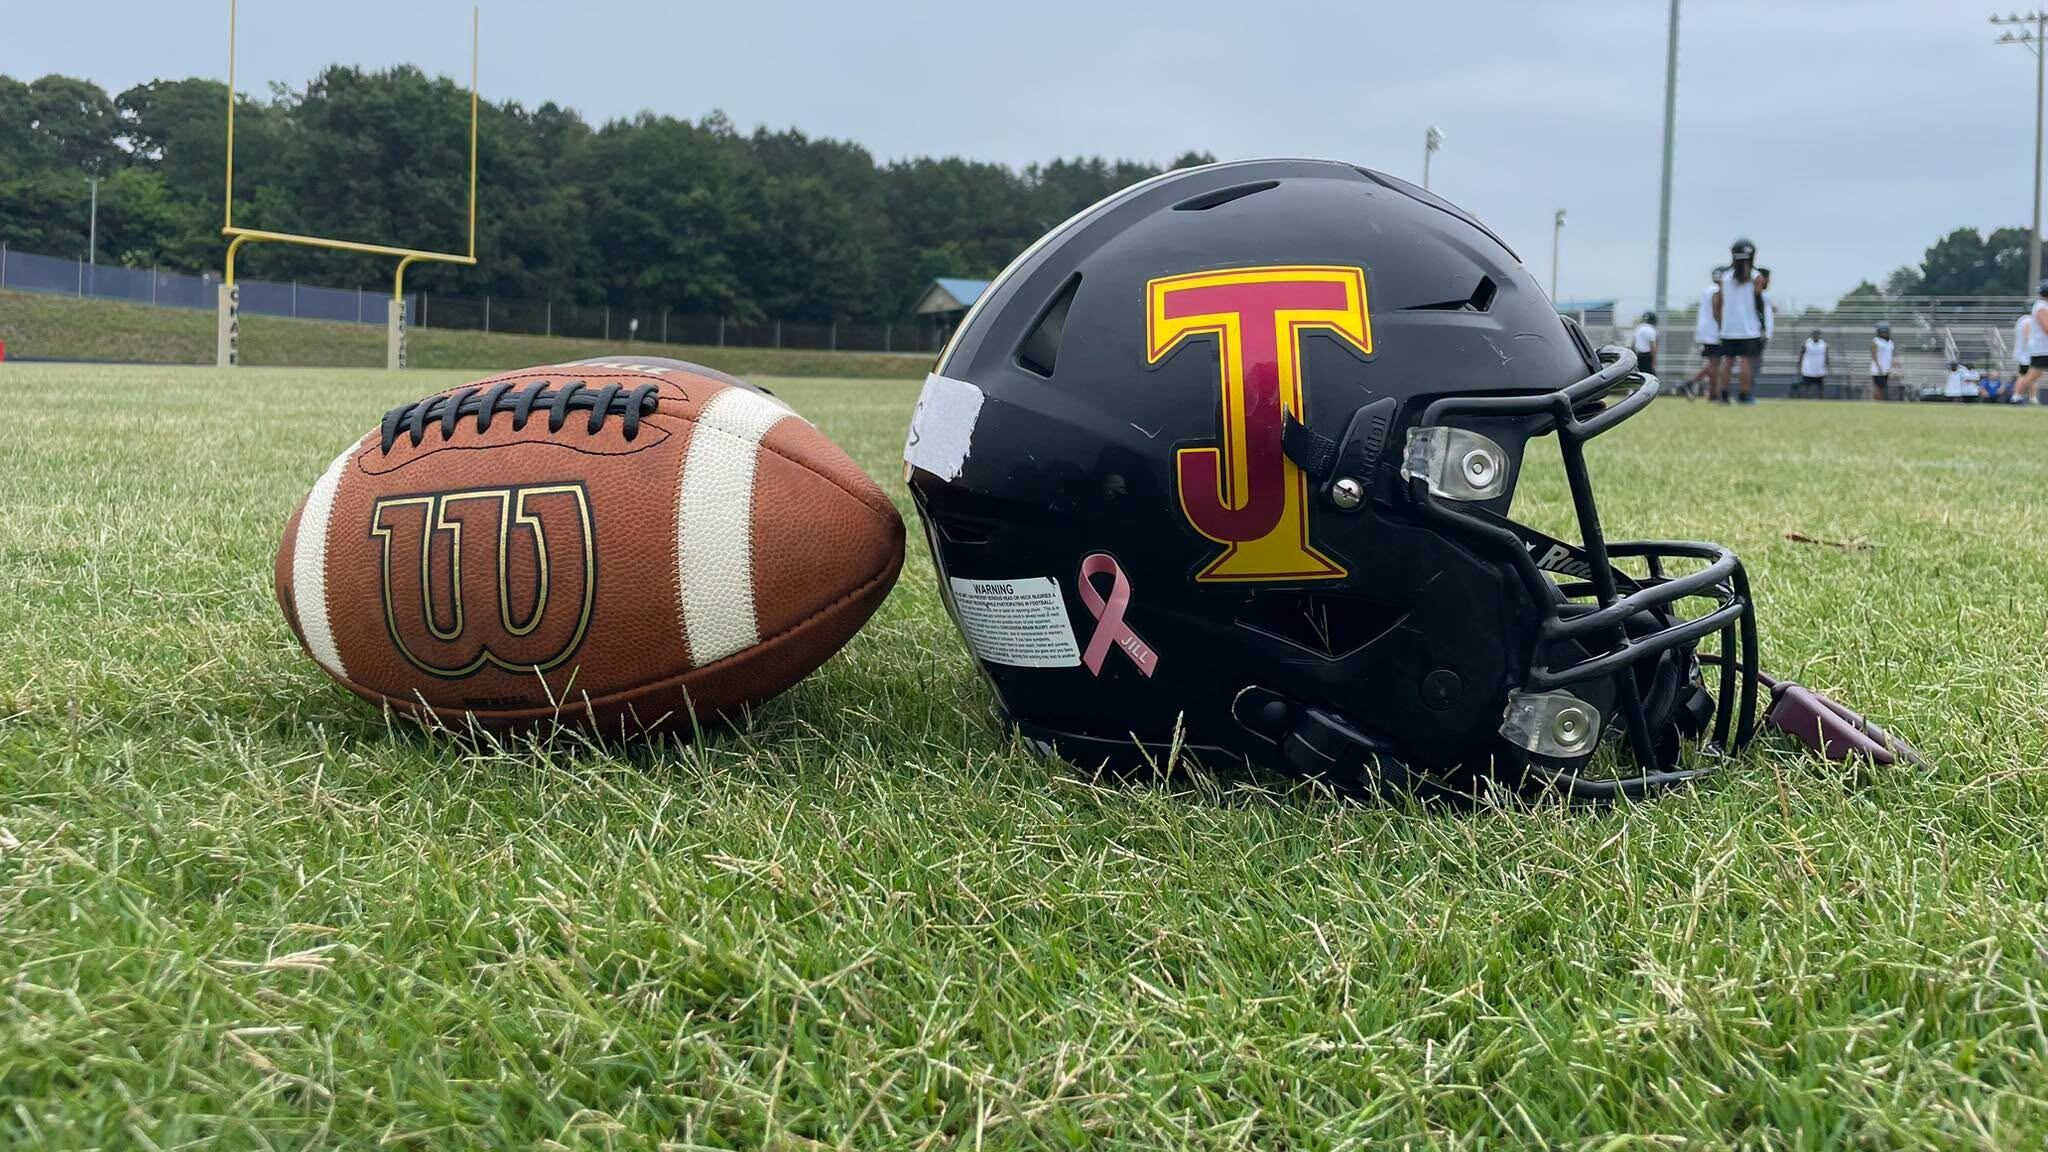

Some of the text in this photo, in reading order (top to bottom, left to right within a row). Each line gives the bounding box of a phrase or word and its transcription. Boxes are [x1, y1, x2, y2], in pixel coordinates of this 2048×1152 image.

[369, 480, 597, 680] W
[973, 583, 1014, 595] WARNING
[1121, 636, 1148, 664] JILL
